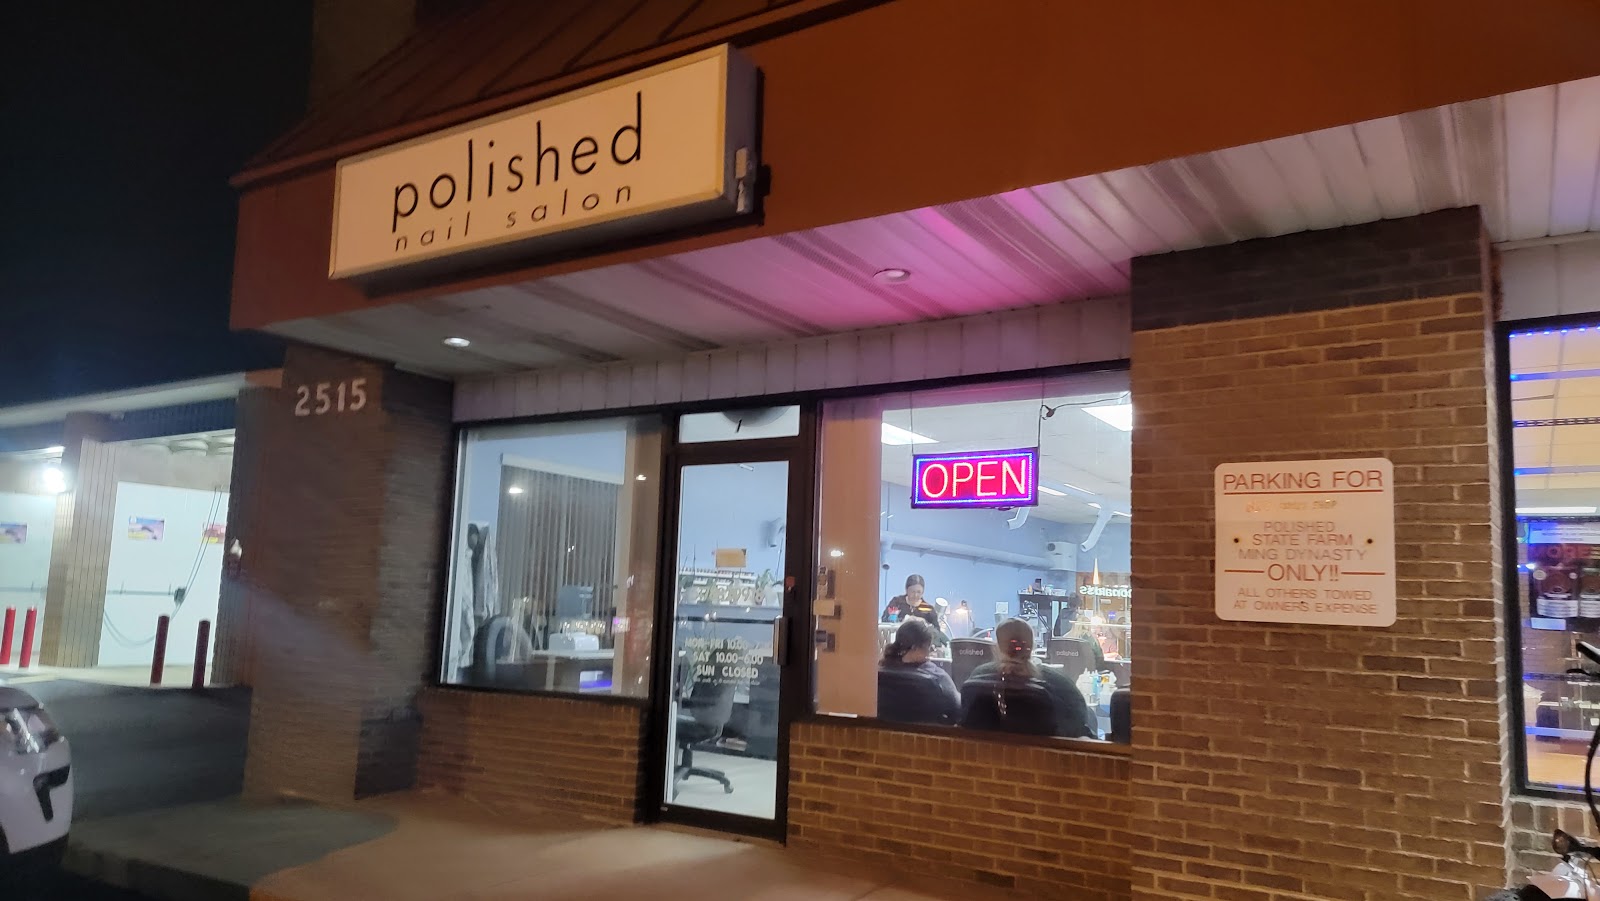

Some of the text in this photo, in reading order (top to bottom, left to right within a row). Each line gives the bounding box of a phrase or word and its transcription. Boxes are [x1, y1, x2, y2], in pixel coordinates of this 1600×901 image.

[391, 90, 642, 232] polished
[395, 184, 632, 252] nail salon
[295, 378, 367, 416] 2515
[922, 459, 1026, 498] OPEN
[1223, 470, 1383, 490] PARKING FOR
[1264, 521, 1336, 533] POLISHED
[1252, 533, 1353, 546] STATE FARM
[1238, 548, 1367, 561] MING DYNASTY
[1267, 563, 1339, 582] ONLY!!
[1237, 587, 1373, 601] ALL OTHERS TOWED
[1234, 600, 1248, 610] AT
[1315, 602, 1377, 614] EXPENSE
[693, 651, 711, 662] SAT
[697, 665, 759, 678] SUN CLOSED
